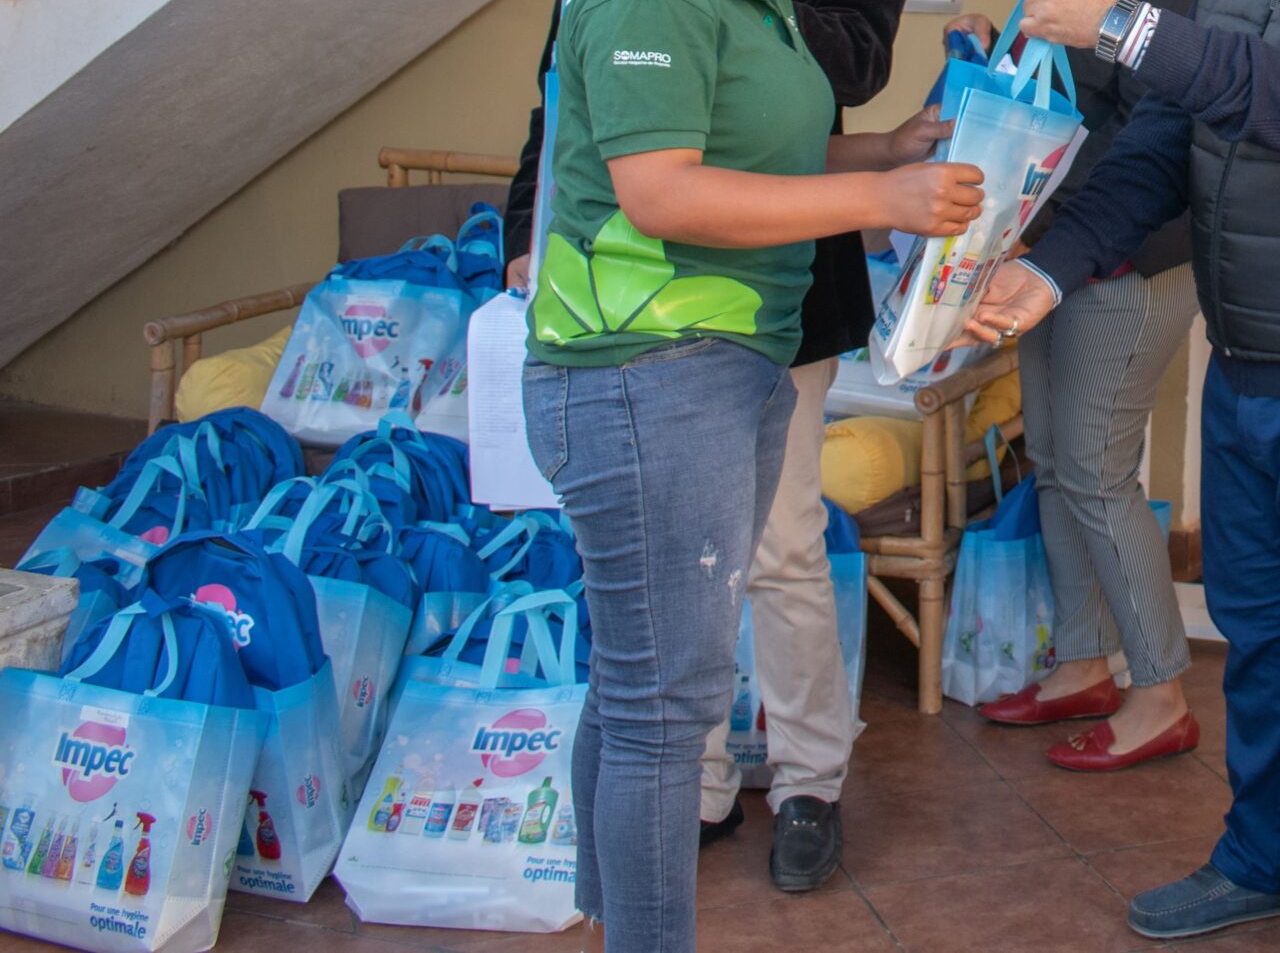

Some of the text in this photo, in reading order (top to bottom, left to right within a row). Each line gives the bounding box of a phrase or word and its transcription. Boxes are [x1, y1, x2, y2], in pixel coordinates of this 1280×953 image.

[613, 50, 671, 63] SOMAPRO
[473, 727, 561, 757] Impec
[55, 732, 134, 777] Impec
[240, 876, 295, 894] optimale
[523, 866, 576, 883] optima
[90, 915, 146, 939] optimale
